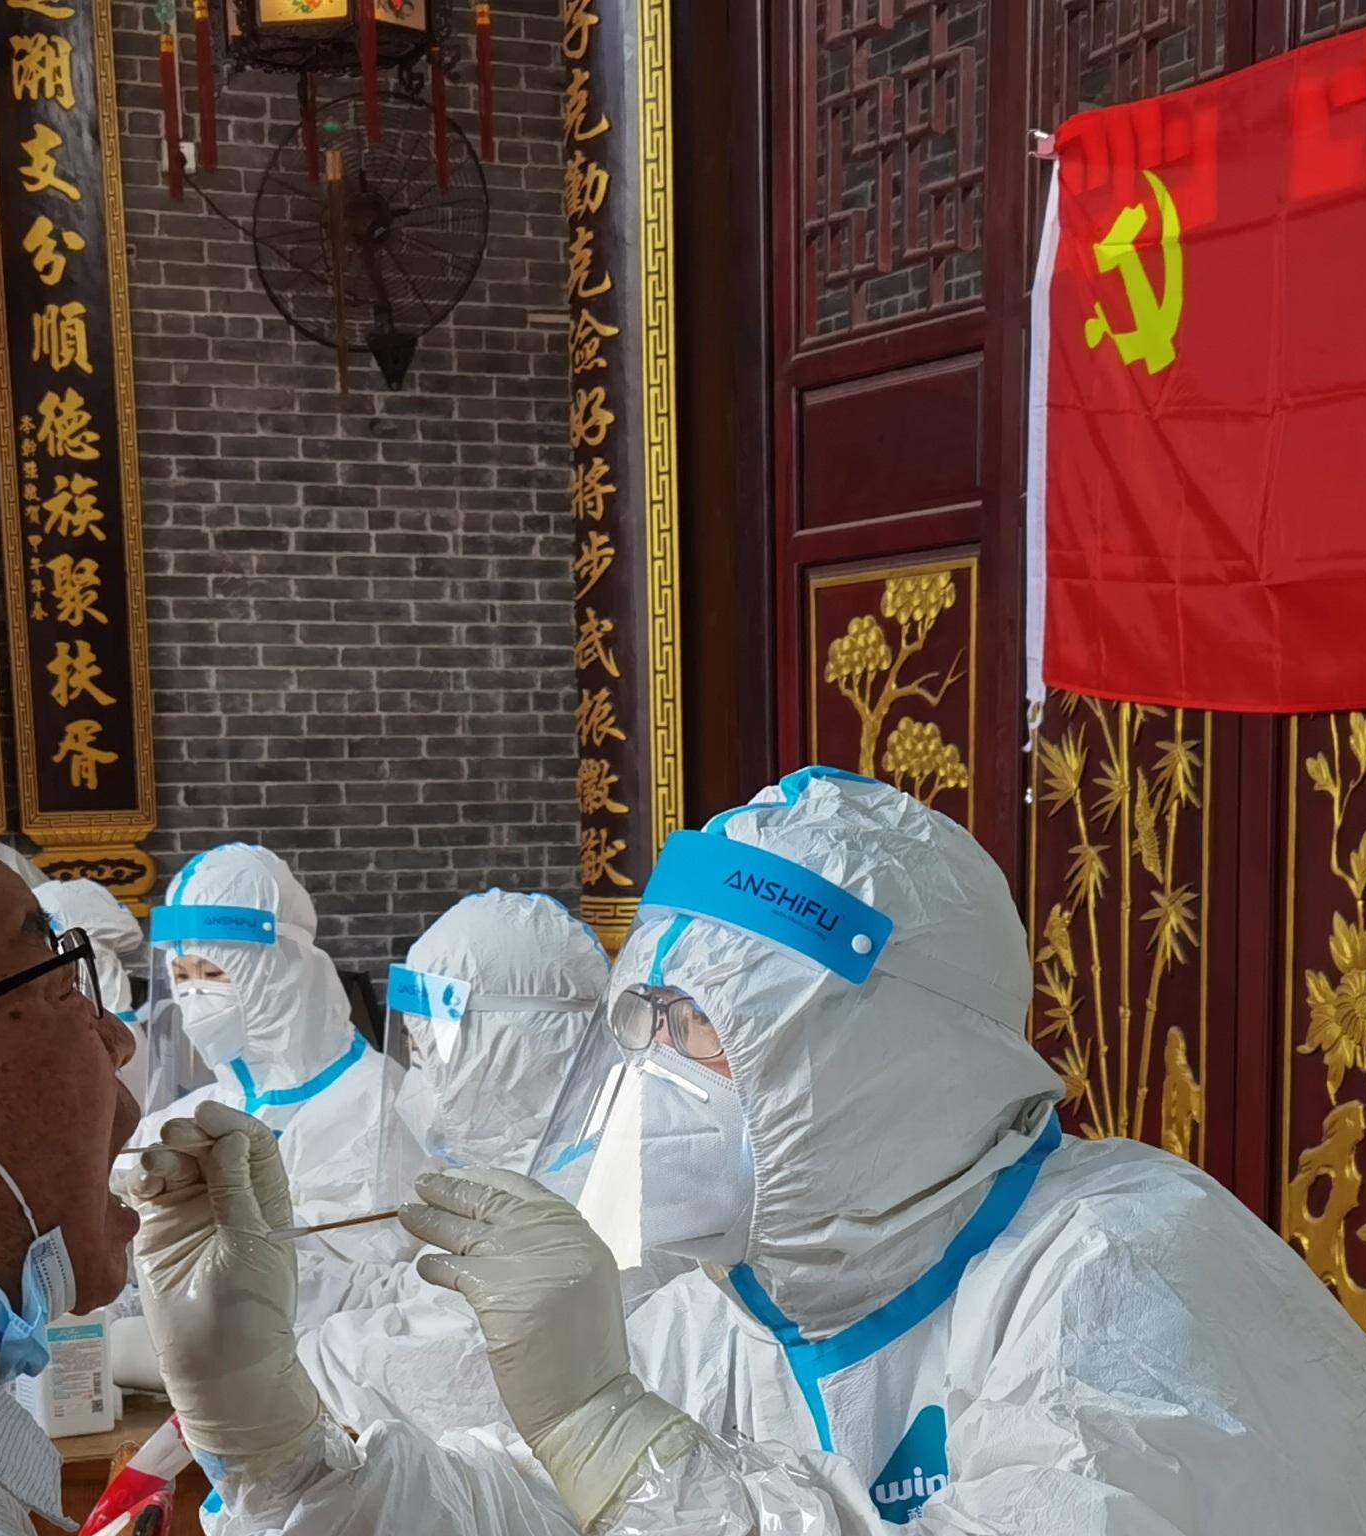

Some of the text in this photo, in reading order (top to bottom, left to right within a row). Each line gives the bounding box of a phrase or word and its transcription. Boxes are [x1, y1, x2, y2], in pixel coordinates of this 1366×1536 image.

[7, 0, 119, 791] 溯支分順德族聚扶胥
[875, 1466, 949, 1504] win
